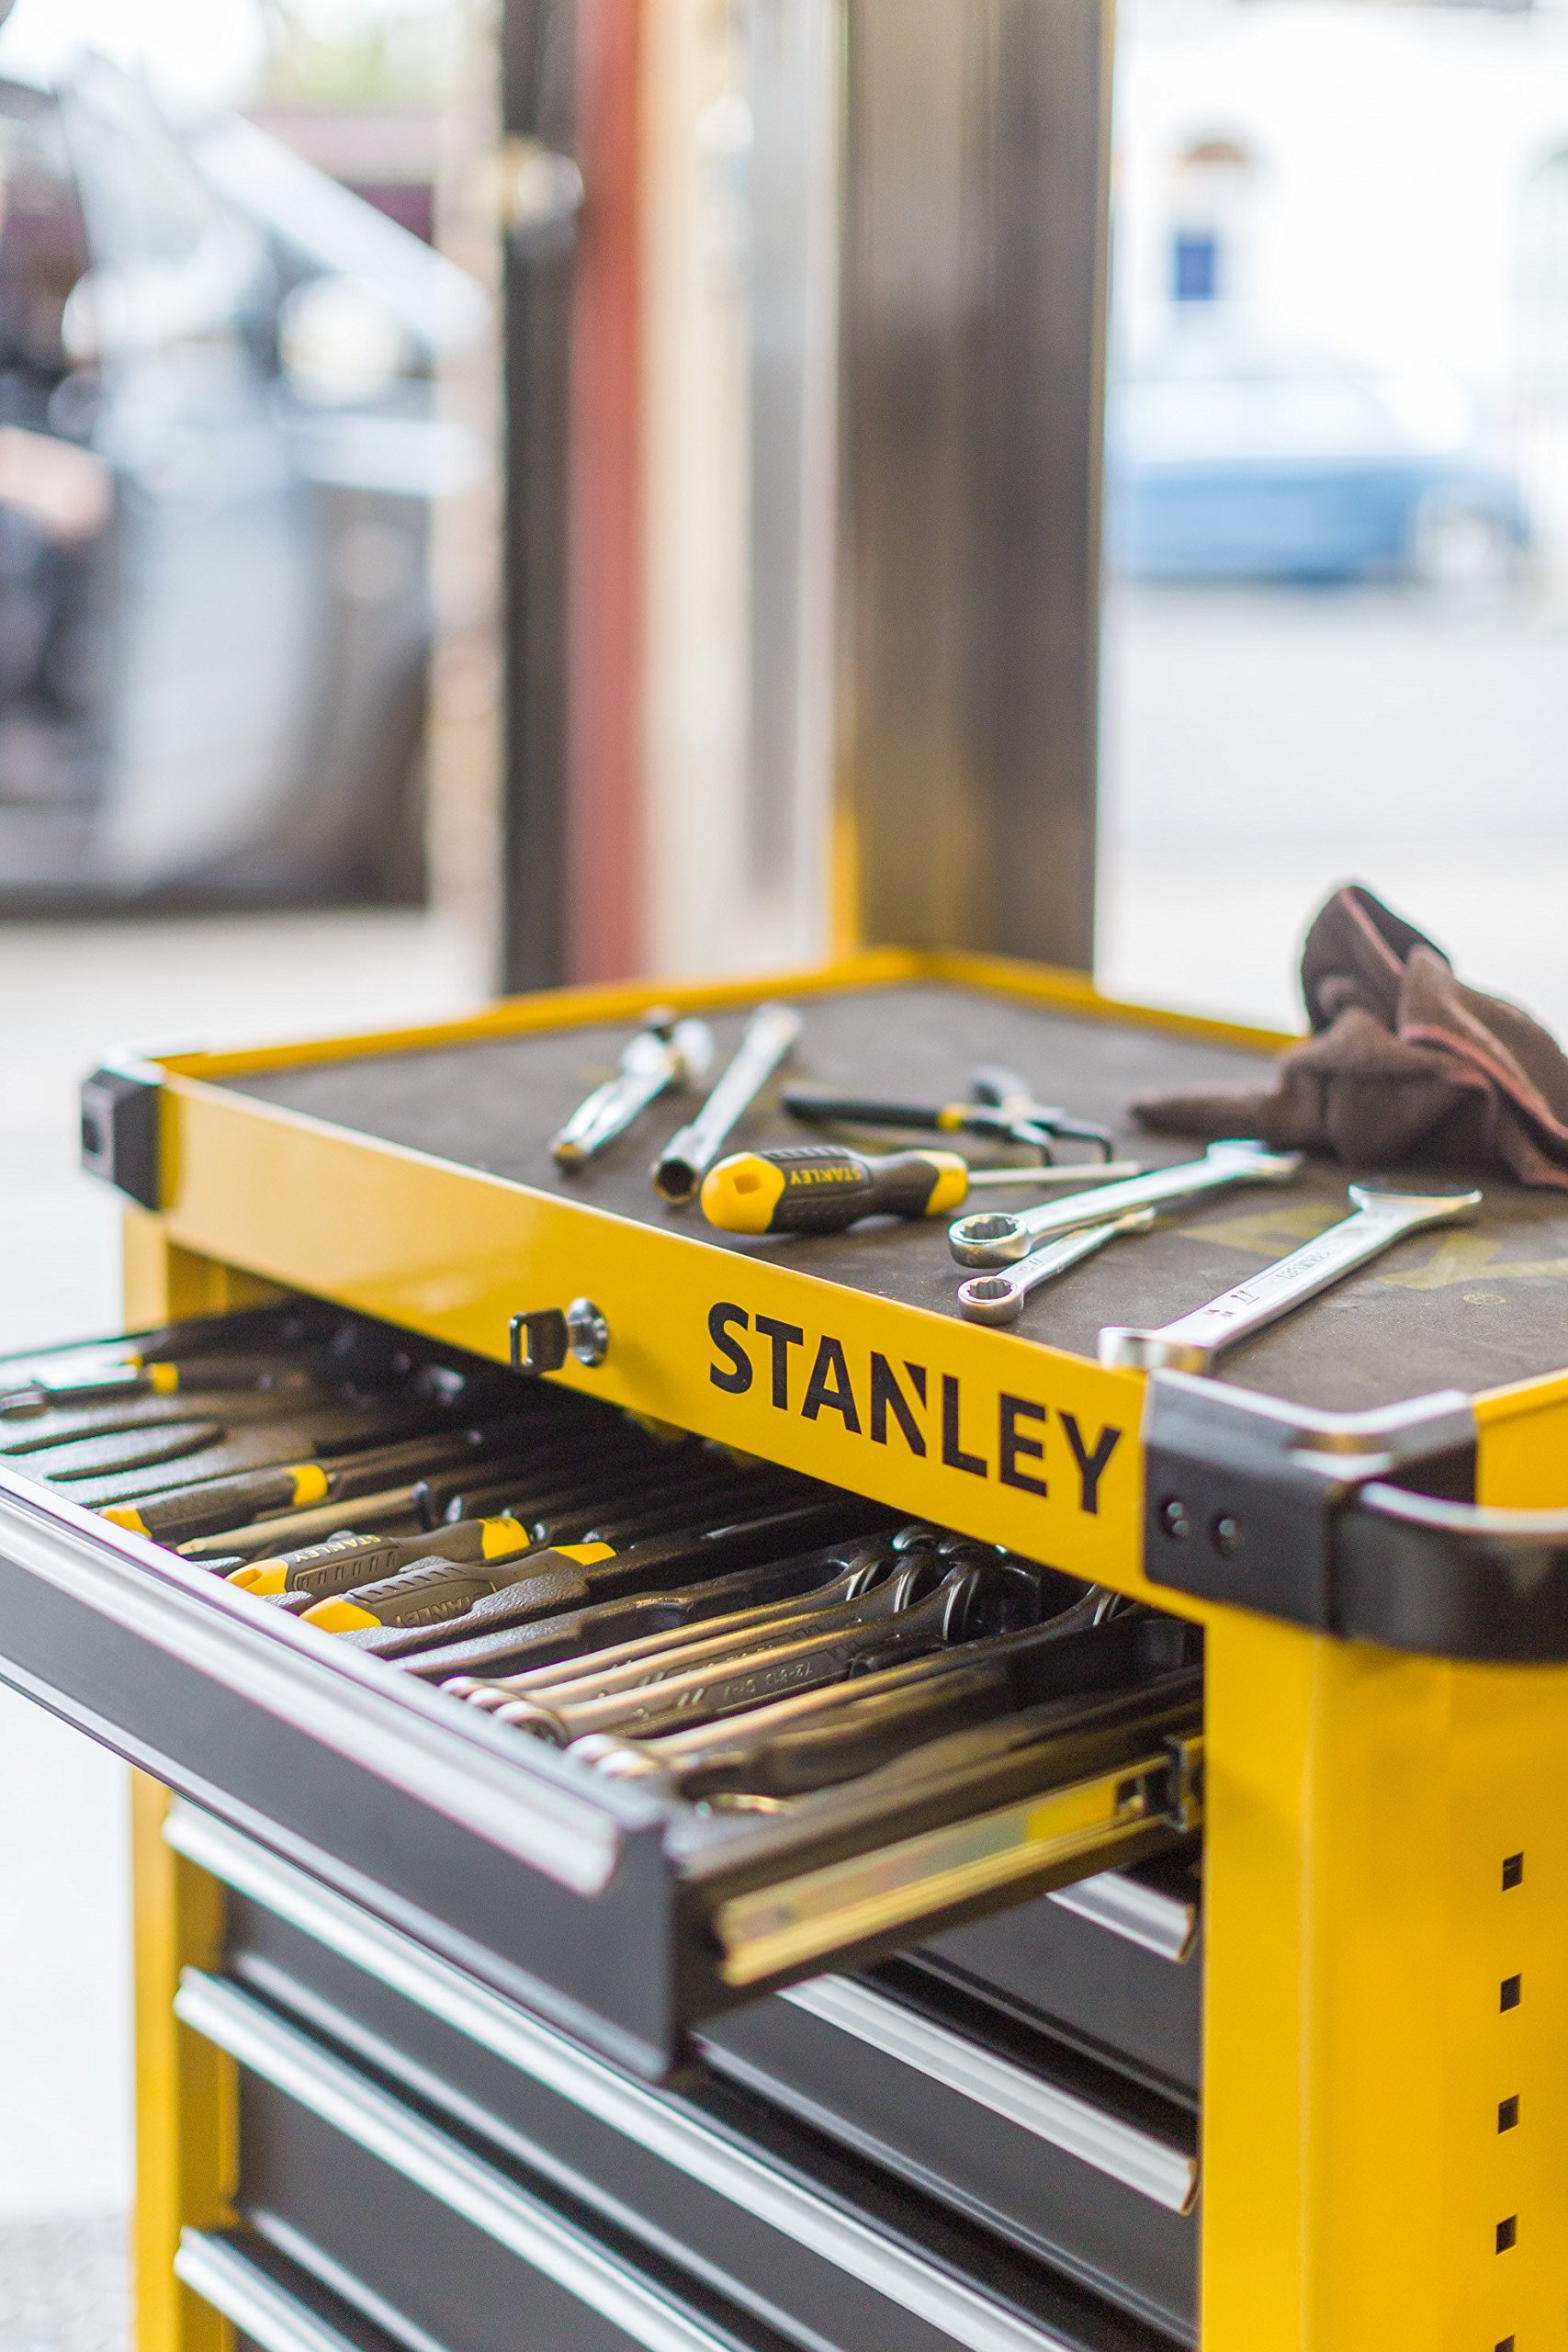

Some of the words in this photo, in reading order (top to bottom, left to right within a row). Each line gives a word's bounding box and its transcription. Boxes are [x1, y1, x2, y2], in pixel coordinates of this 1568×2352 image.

[790, 1165, 863, 1185] STANLEY
[706, 1301, 1122, 1516] STANLEY
[295, 1534, 381, 1563] STANLEY
